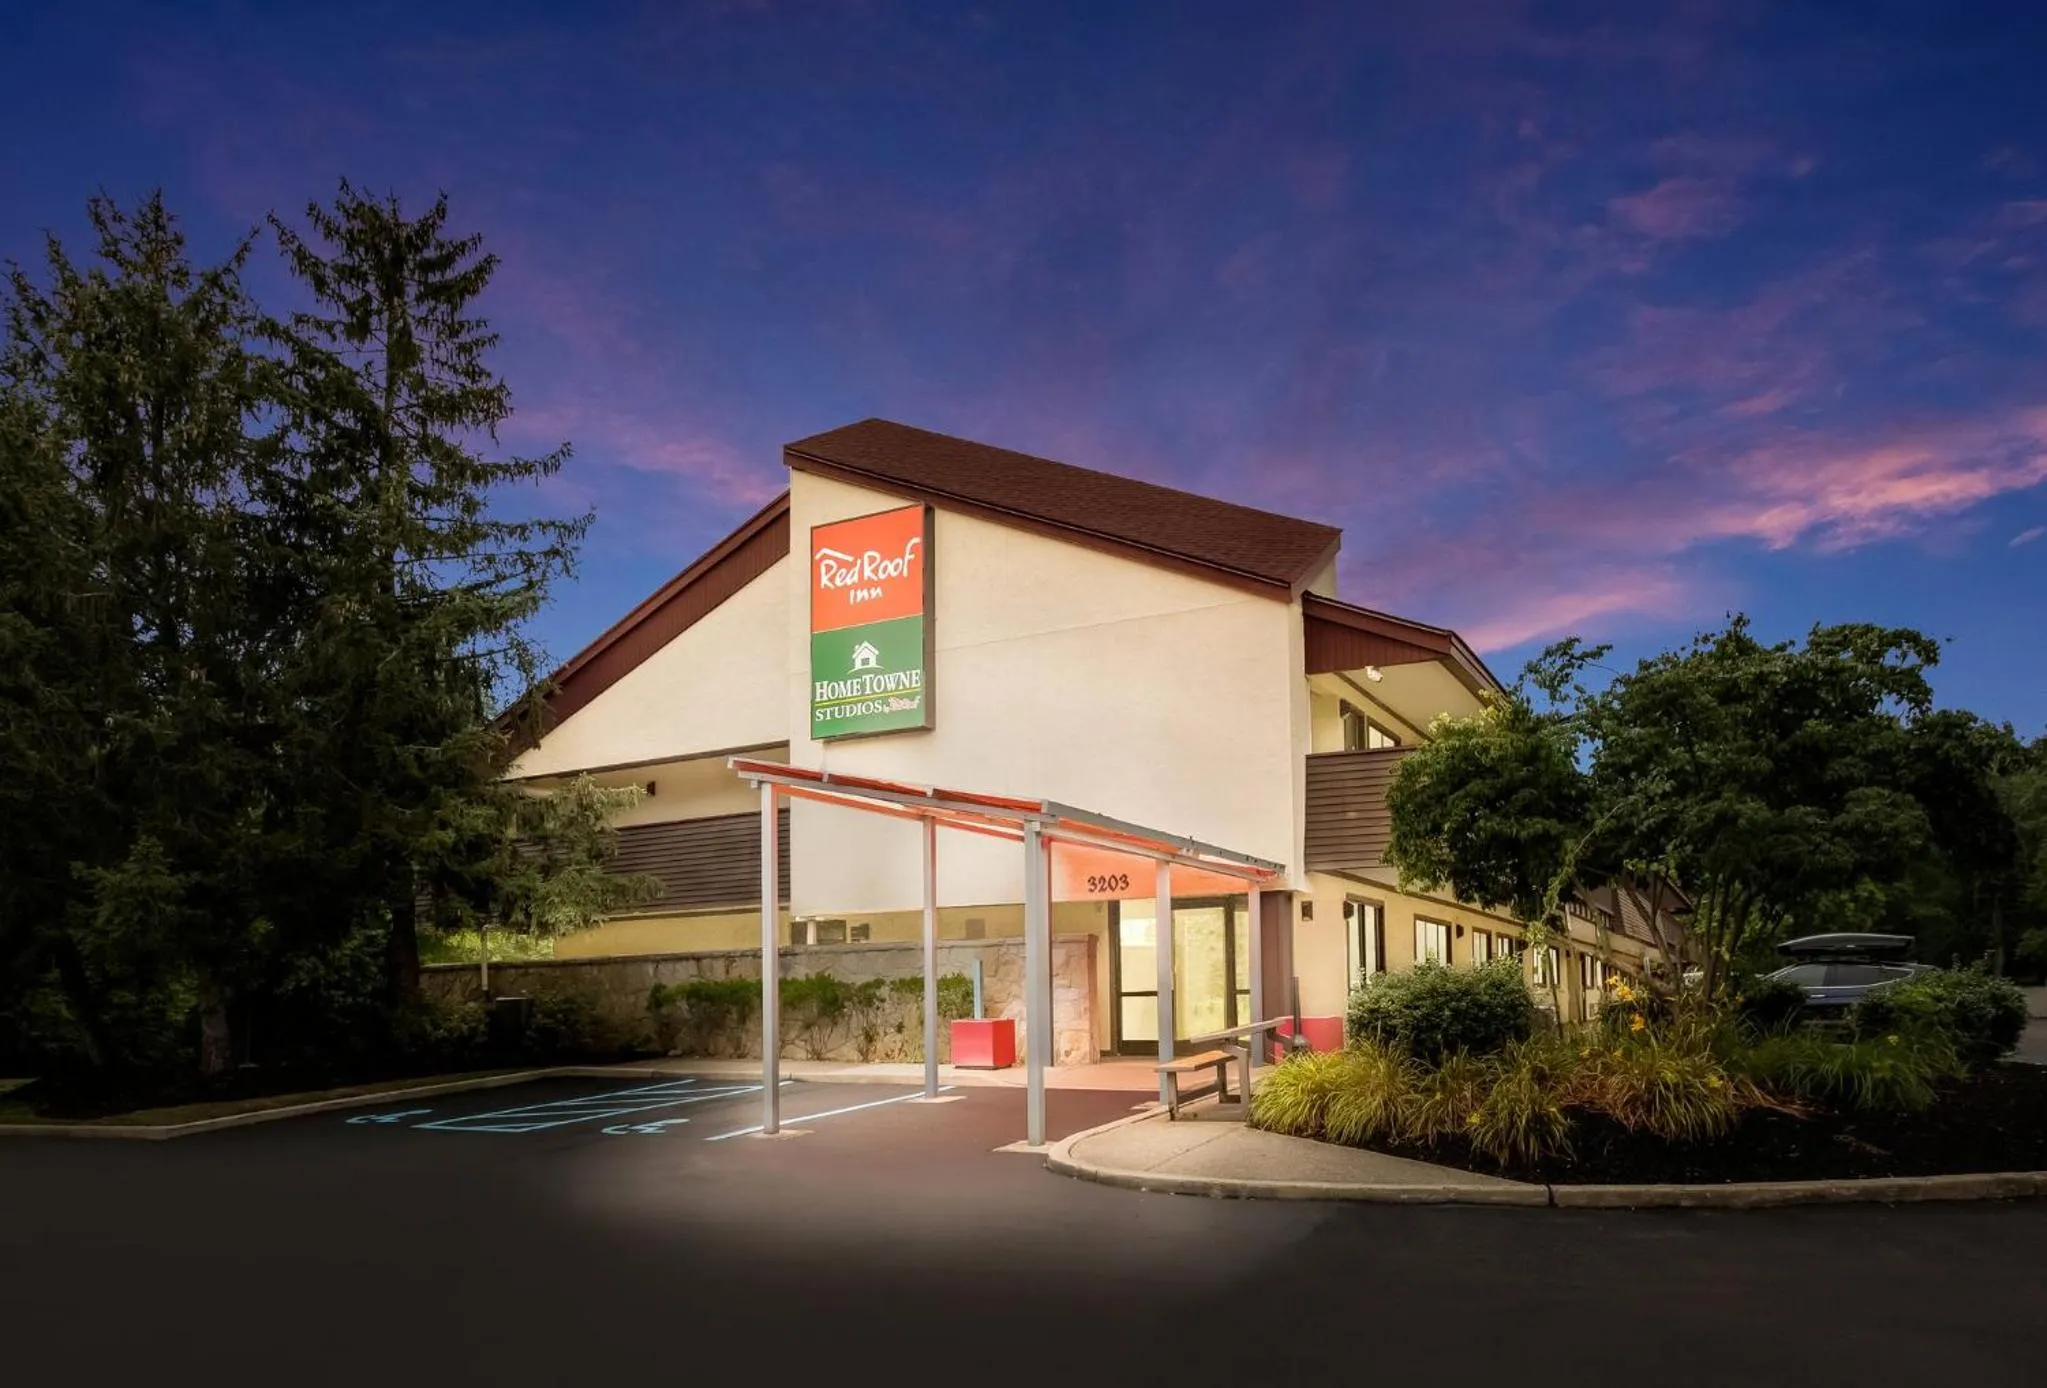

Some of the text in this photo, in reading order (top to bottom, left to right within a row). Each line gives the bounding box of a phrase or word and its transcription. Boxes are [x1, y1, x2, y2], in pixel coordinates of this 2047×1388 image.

[820, 537, 920, 589] Red Roof
[815, 699, 882, 721] STUDIOS
[1087, 873, 1129, 892] 3203
